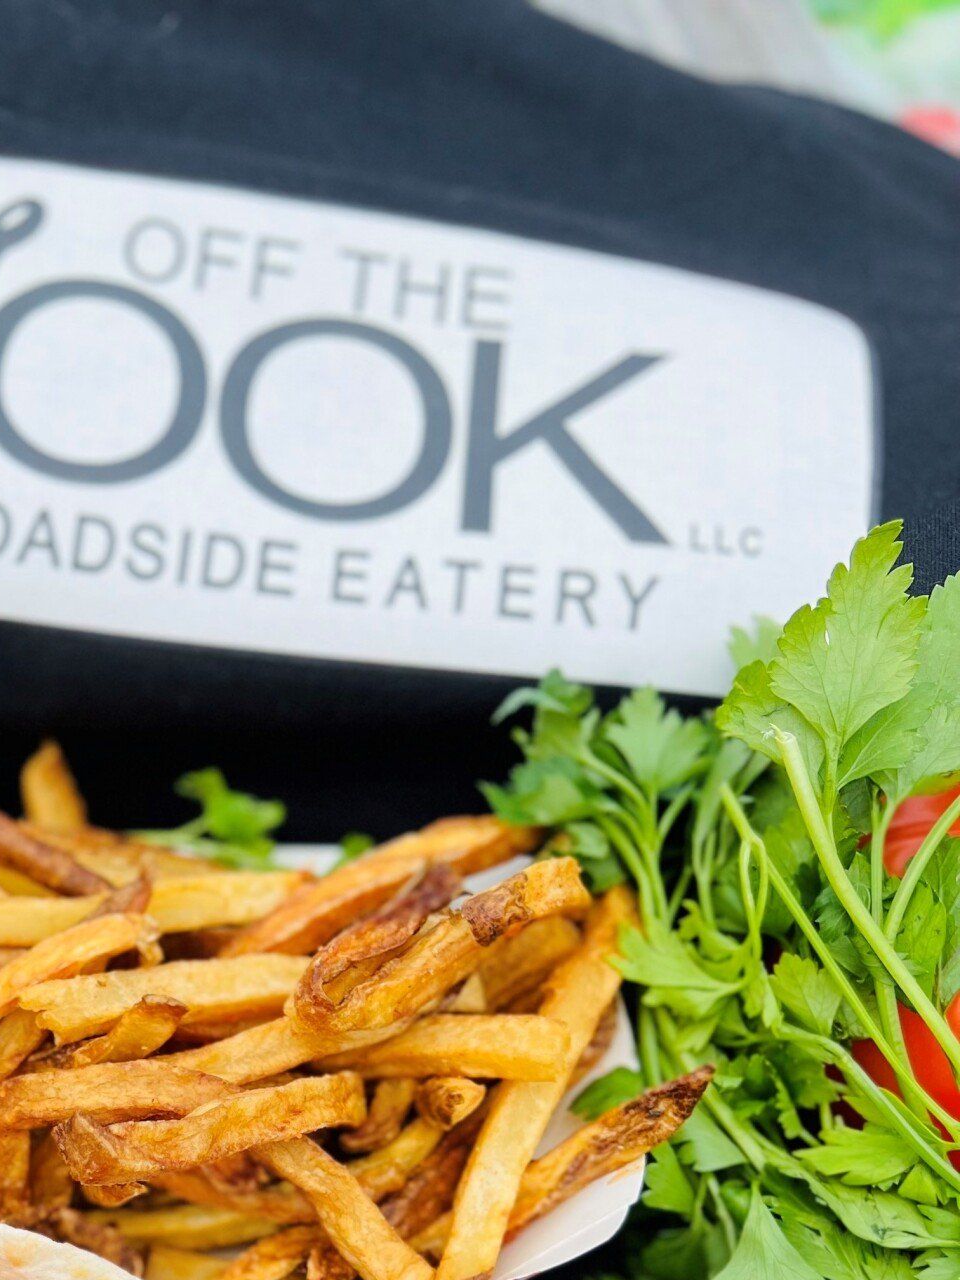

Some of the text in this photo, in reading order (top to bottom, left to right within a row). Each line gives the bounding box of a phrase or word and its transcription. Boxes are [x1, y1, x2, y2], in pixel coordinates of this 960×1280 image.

[123, 217, 514, 332] OFF THE
[688, 523, 765, 558] LLC
[330, 549, 661, 634] EATERY
